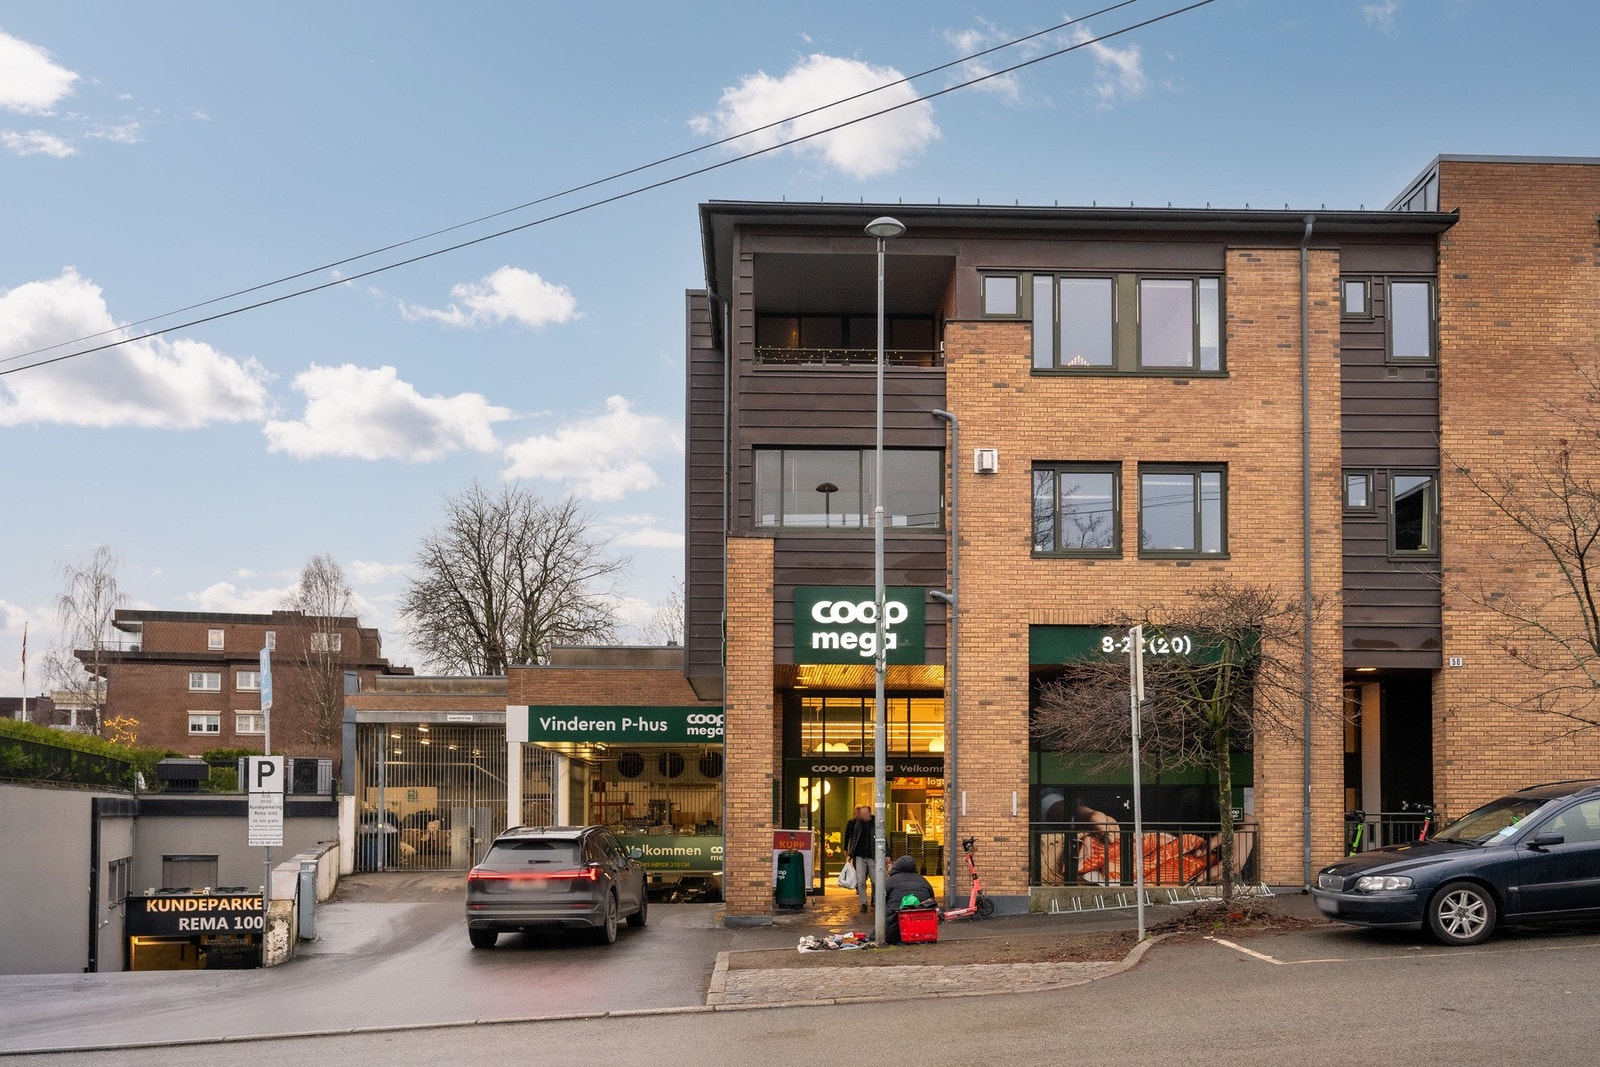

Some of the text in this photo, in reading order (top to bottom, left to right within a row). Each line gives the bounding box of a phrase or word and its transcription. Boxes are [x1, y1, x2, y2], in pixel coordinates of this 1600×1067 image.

[811, 600, 908, 629] coop
[812, 631, 897, 657] mega
[1149, 635, 1191, 655] (20)
[539, 715, 668, 732] Vinderen P-hus
[686, 713, 724, 727] coop
[686, 726, 724, 739] mega
[257, 760, 276, 788] P
[811, 764, 849, 774] coop
[851, 764, 894, 773] mea
[146, 897, 263, 913] KUNDEPARKE
[178, 916, 264, 931] REMA 100
